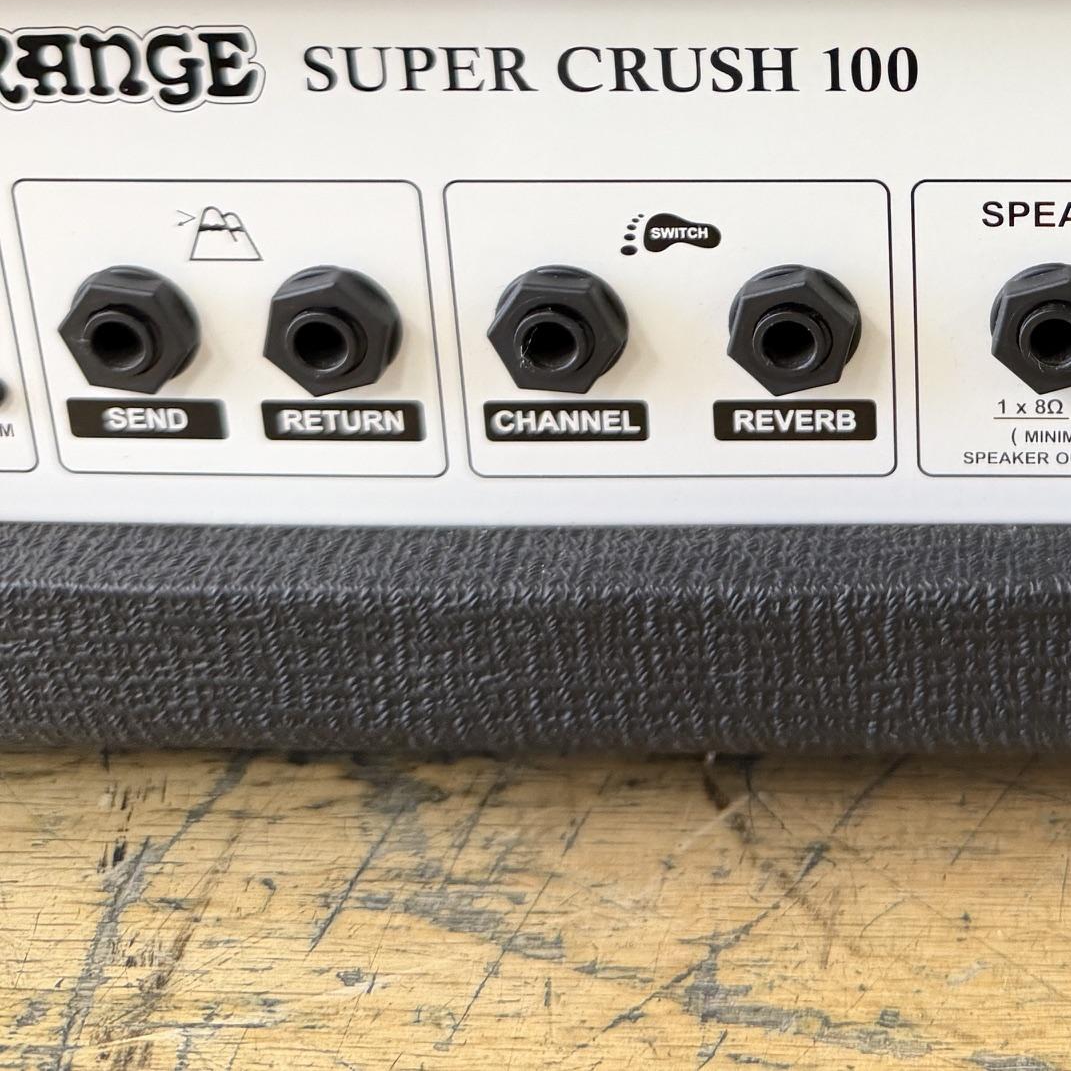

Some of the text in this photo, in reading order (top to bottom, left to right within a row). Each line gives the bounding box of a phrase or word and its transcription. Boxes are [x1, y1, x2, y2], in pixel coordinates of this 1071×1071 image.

[303, 45, 539, 93] SUPER
[557, 46, 801, 93] CRUSH
[822, 46, 919, 93] 100
[650, 226, 709, 240] SWITCH
[997, 398, 1006, 415] 1
[1016, 402, 1027, 415] x
[1034, 398, 1064, 415] 8Ω
[105, 406, 189, 432] SEND
[278, 409, 405, 434] RETURN
[491, 409, 641, 434] CHANNEL
[733, 409, 857, 433] REVERB
[963, 451, 1049, 465] SPEAKER
